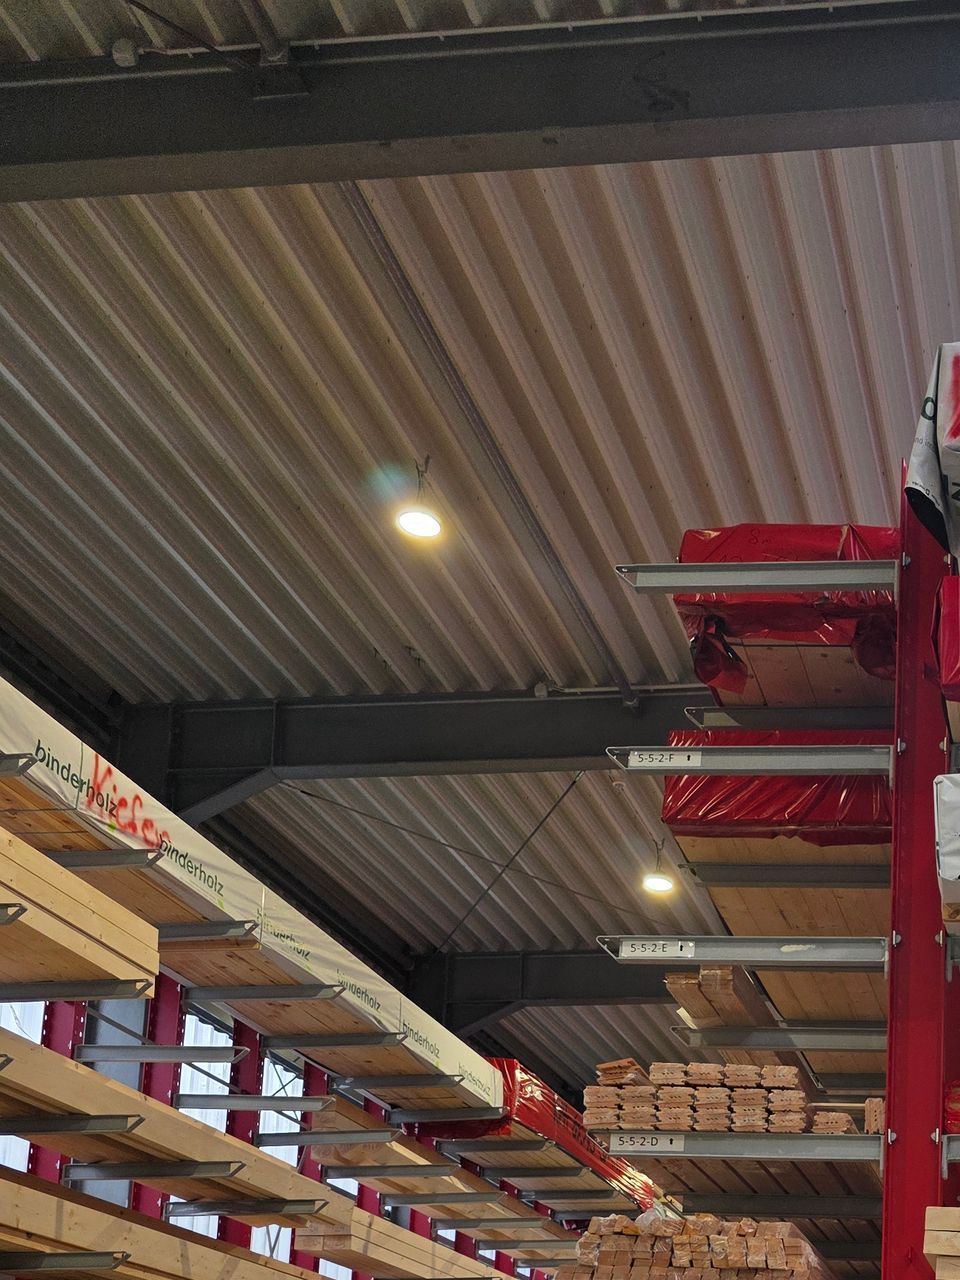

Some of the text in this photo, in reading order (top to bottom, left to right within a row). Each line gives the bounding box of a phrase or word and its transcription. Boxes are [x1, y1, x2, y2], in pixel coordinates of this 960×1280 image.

[637, 753, 675, 763] 5-5-2-F
[34, 739, 119, 819] binderholz
[159, 834, 225, 898] binderholz
[630, 943, 668, 953] 5-5-2-E
[402, 1019, 440, 1058] binderholz
[617, 1136, 659, 1147] 5-5-2-D
